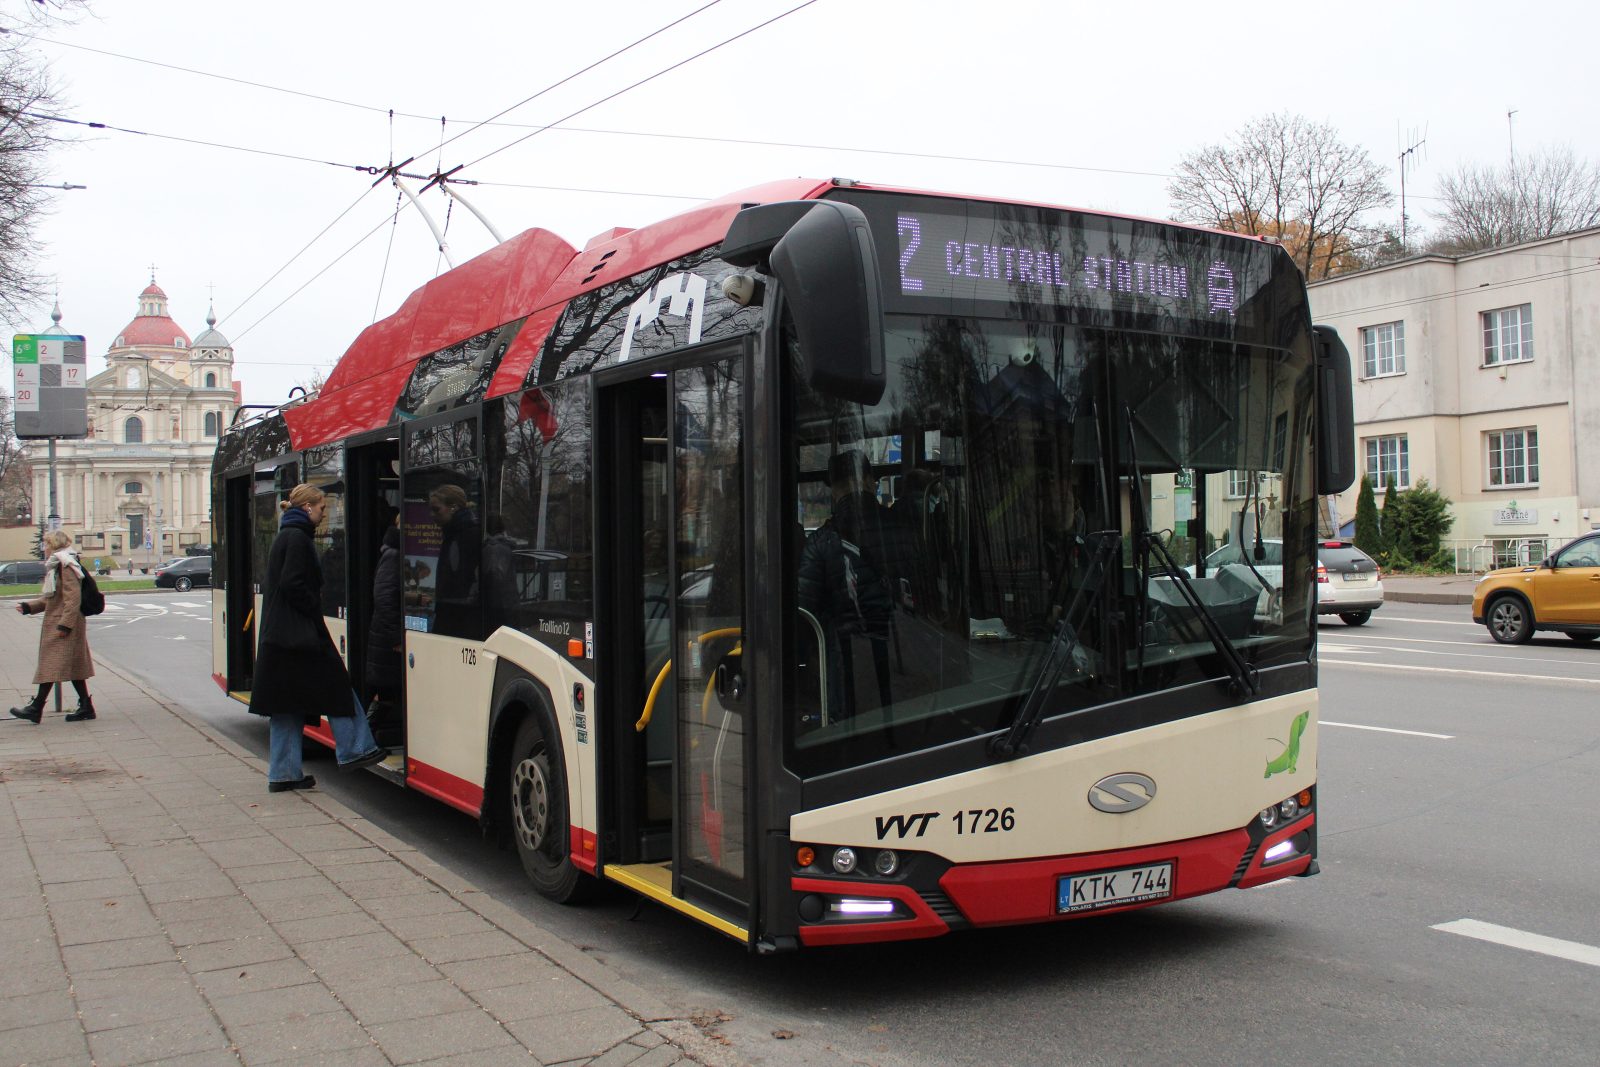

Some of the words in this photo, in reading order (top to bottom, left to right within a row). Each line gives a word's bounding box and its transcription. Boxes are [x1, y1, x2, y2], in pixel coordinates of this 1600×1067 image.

[897, 216, 923, 291] 2
[946, 241, 1069, 286] CENTRAL
[1083, 256, 1187, 299] STATION
[41, 345, 47, 354] 2
[17, 369, 24, 378] 4
[67, 368, 78, 378] 17
[18, 390, 30, 399] 20
[539, 618, 563, 635] Trollino
[563, 621, 570, 636] 12
[461, 648, 477, 666] 1726
[952, 807, 1015, 835] 1726
[1073, 874, 1117, 903] KTK
[1132, 868, 1167, 894] 744
[1060, 895, 1069, 905] LT
